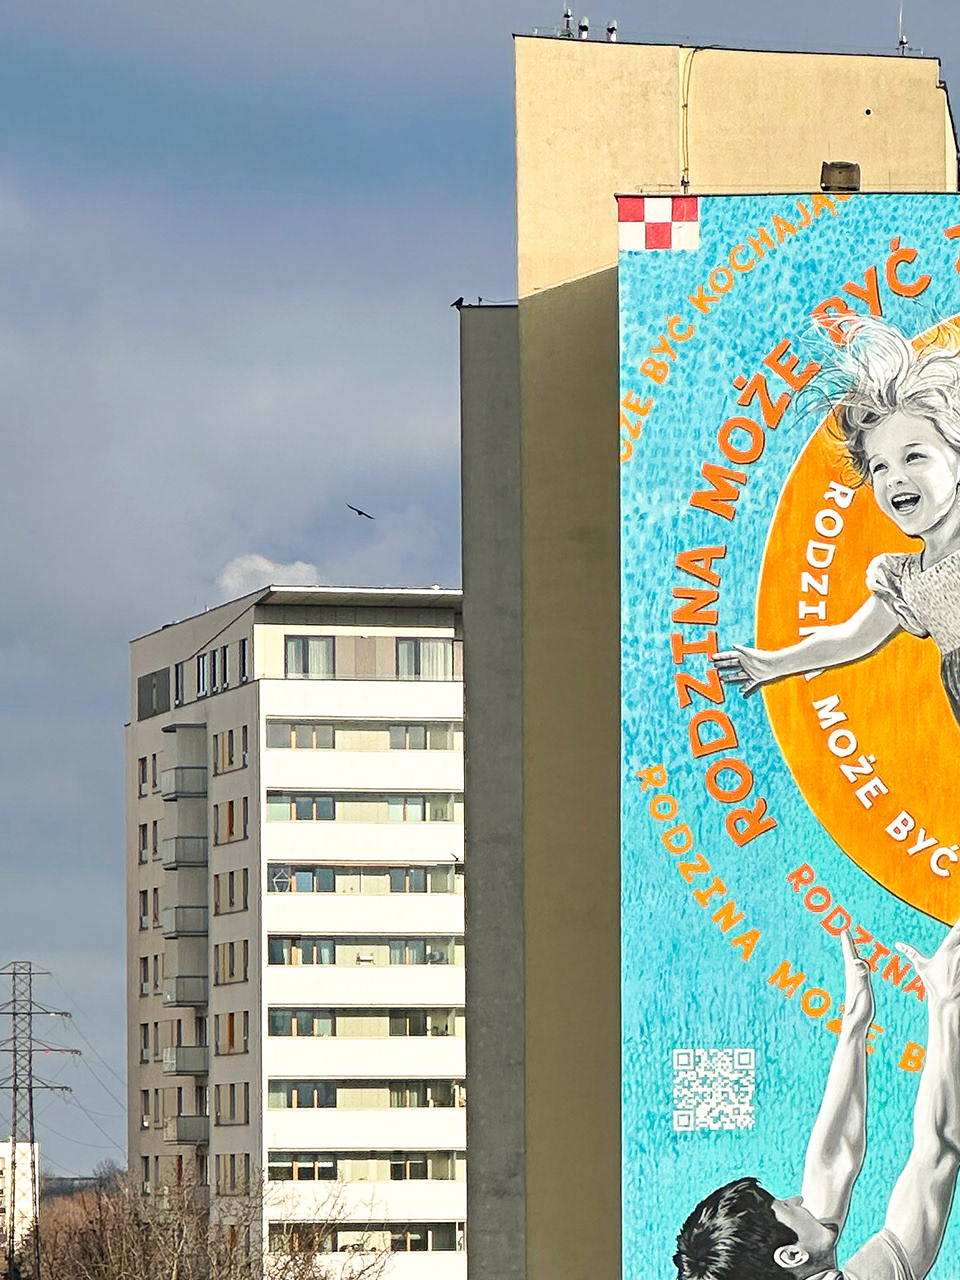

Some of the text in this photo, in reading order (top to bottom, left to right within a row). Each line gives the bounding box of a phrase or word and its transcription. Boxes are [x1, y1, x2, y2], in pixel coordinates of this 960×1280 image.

[640, 314, 695, 385] BYĆ
[689, 194, 851, 315] KOCHAJĄ
[810, 237, 931, 347] BYĆ
[689, 338, 821, 521] MOŻE
[670, 546, 777, 847] RODZINA
[812, 694, 889, 809] MOŻE
[885, 810, 960, 878] BYĆ
[637, 764, 762, 962] RODZINA
[786, 863, 928, 1002] RODZINA
